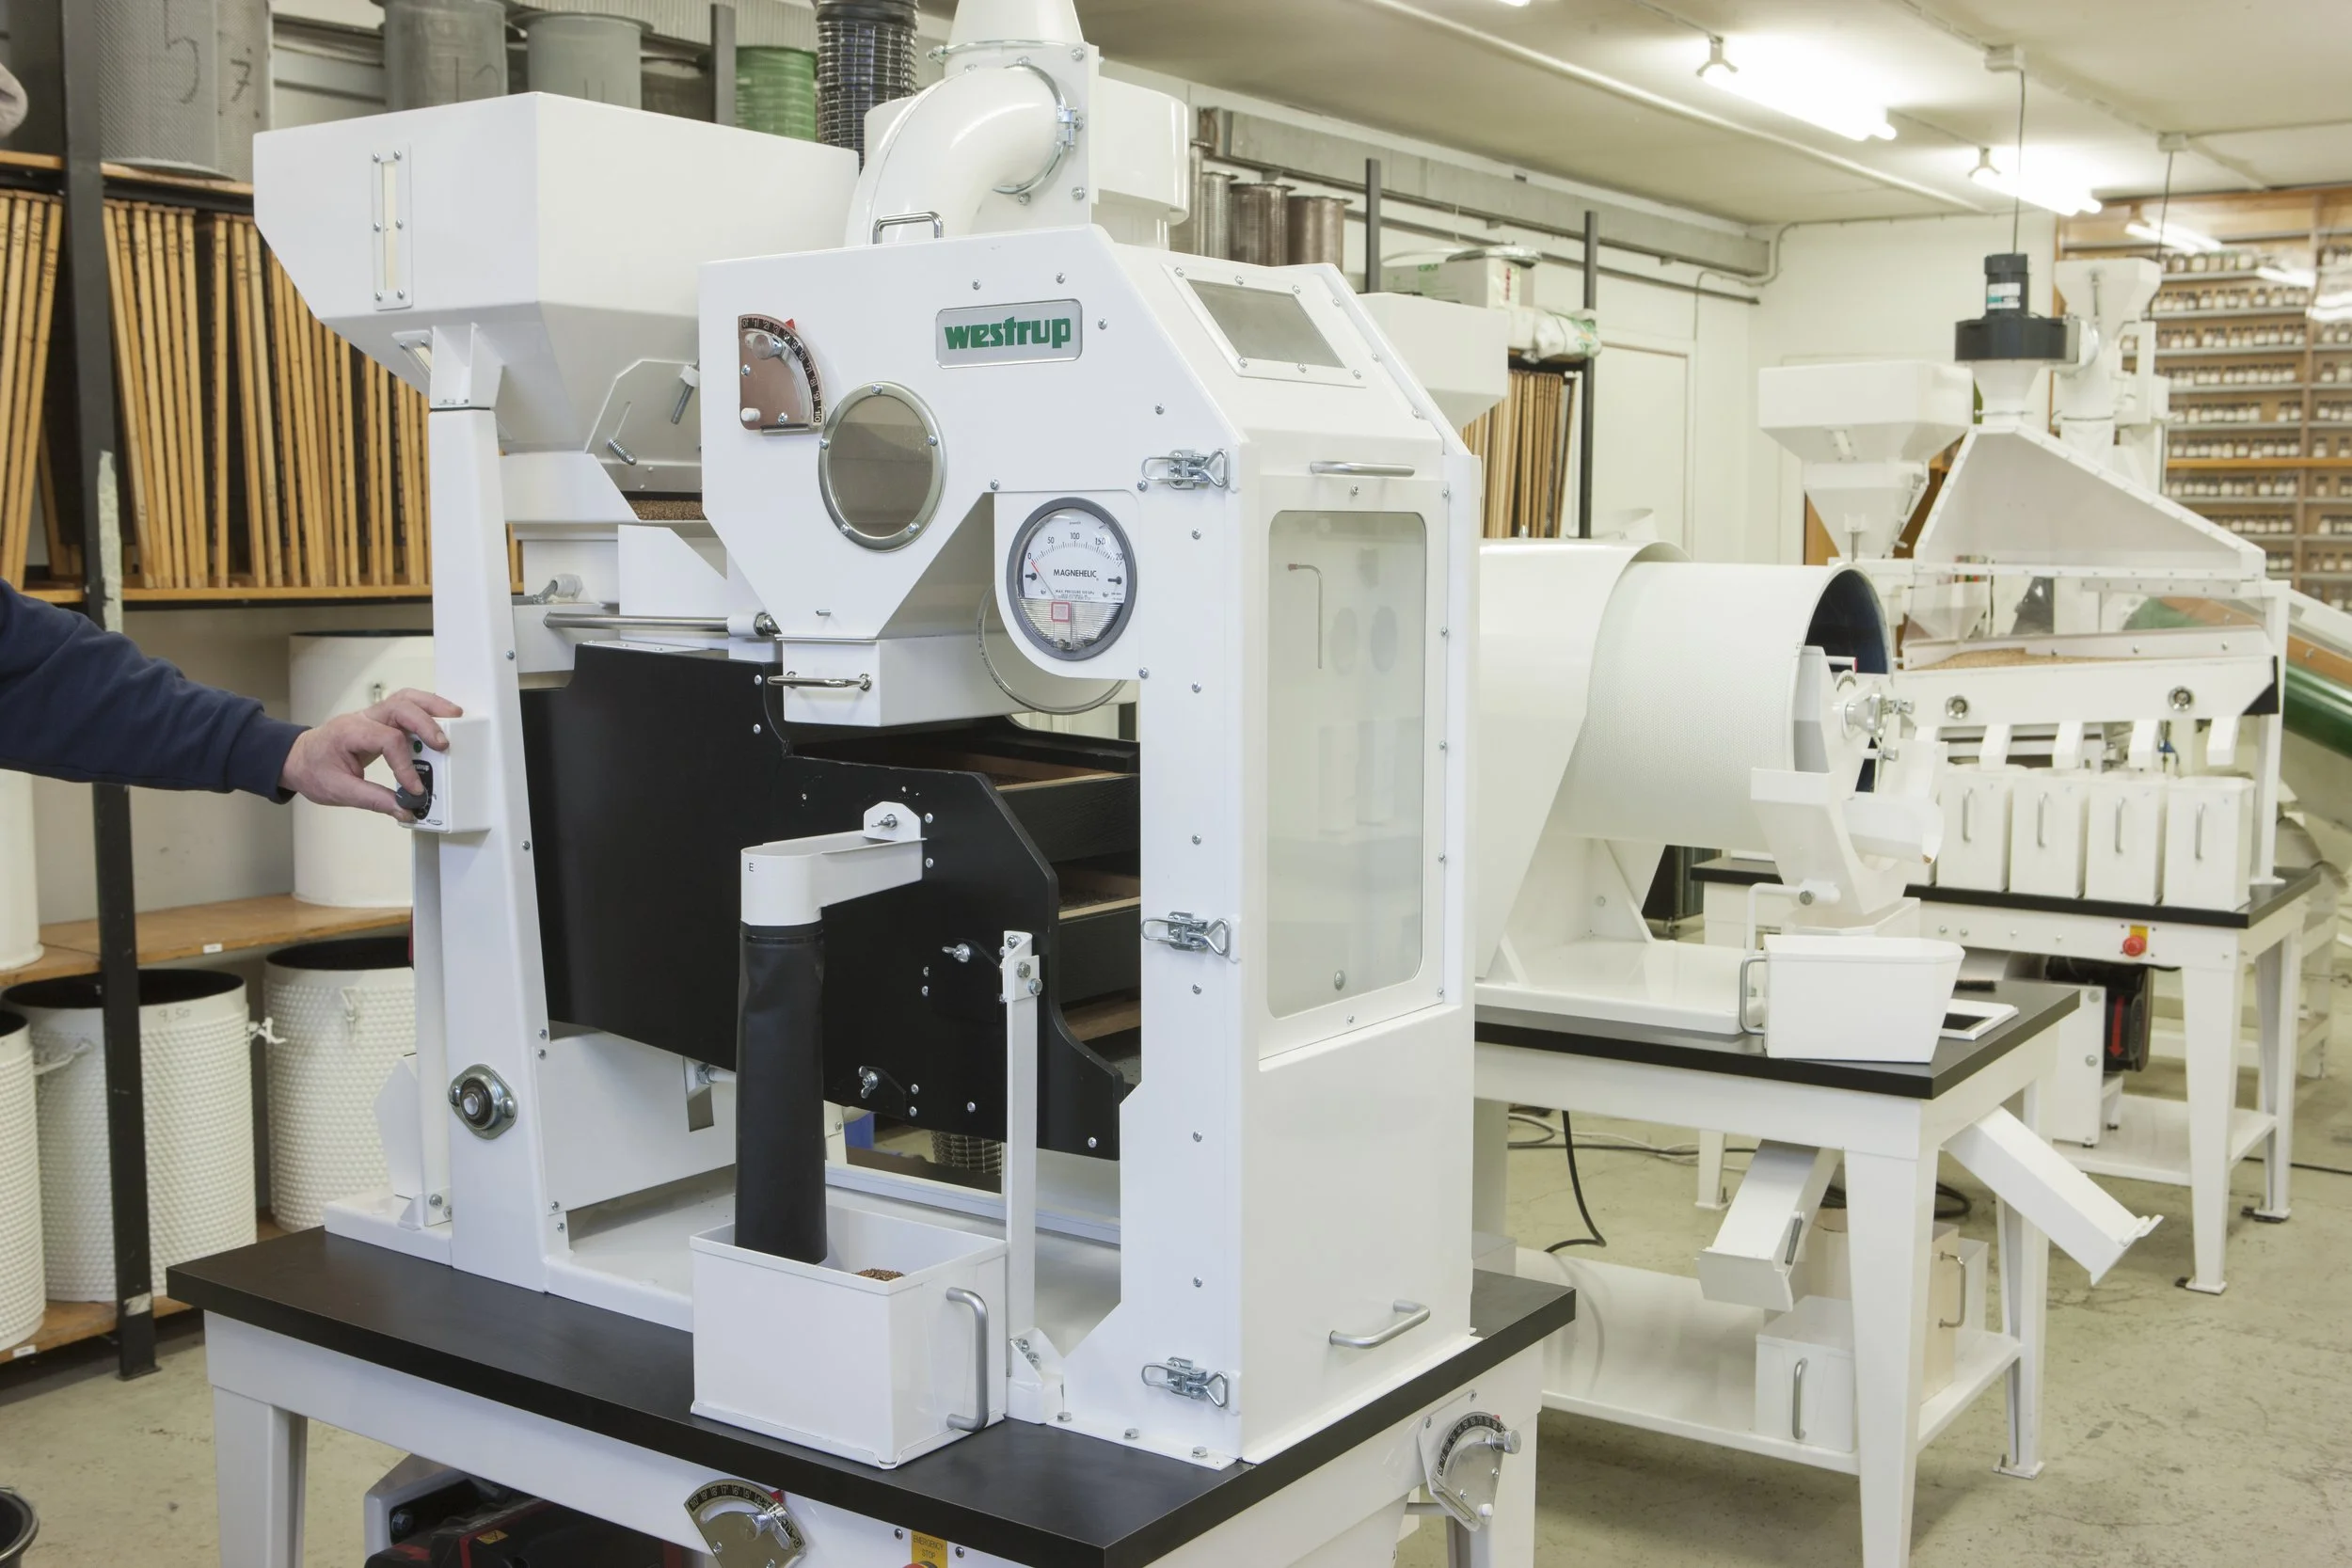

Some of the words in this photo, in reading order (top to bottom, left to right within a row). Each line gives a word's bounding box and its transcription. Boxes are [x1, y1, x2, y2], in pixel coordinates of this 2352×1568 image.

[945, 316, 1071, 350] westrup
[814, 409, 821, 422] 10
[1047, 536, 1055, 545] 50
[1070, 531, 1080, 540] 100
[1095, 537, 1106, 546] 150
[1115, 553, 1124, 562] 20
[1053, 568, 1098, 578] MAGNEHELIC
[748, 862, 755, 872] E
[913, 1535, 944, 1550] EMERGENCY
[921, 1548, 936, 1560] STOP
